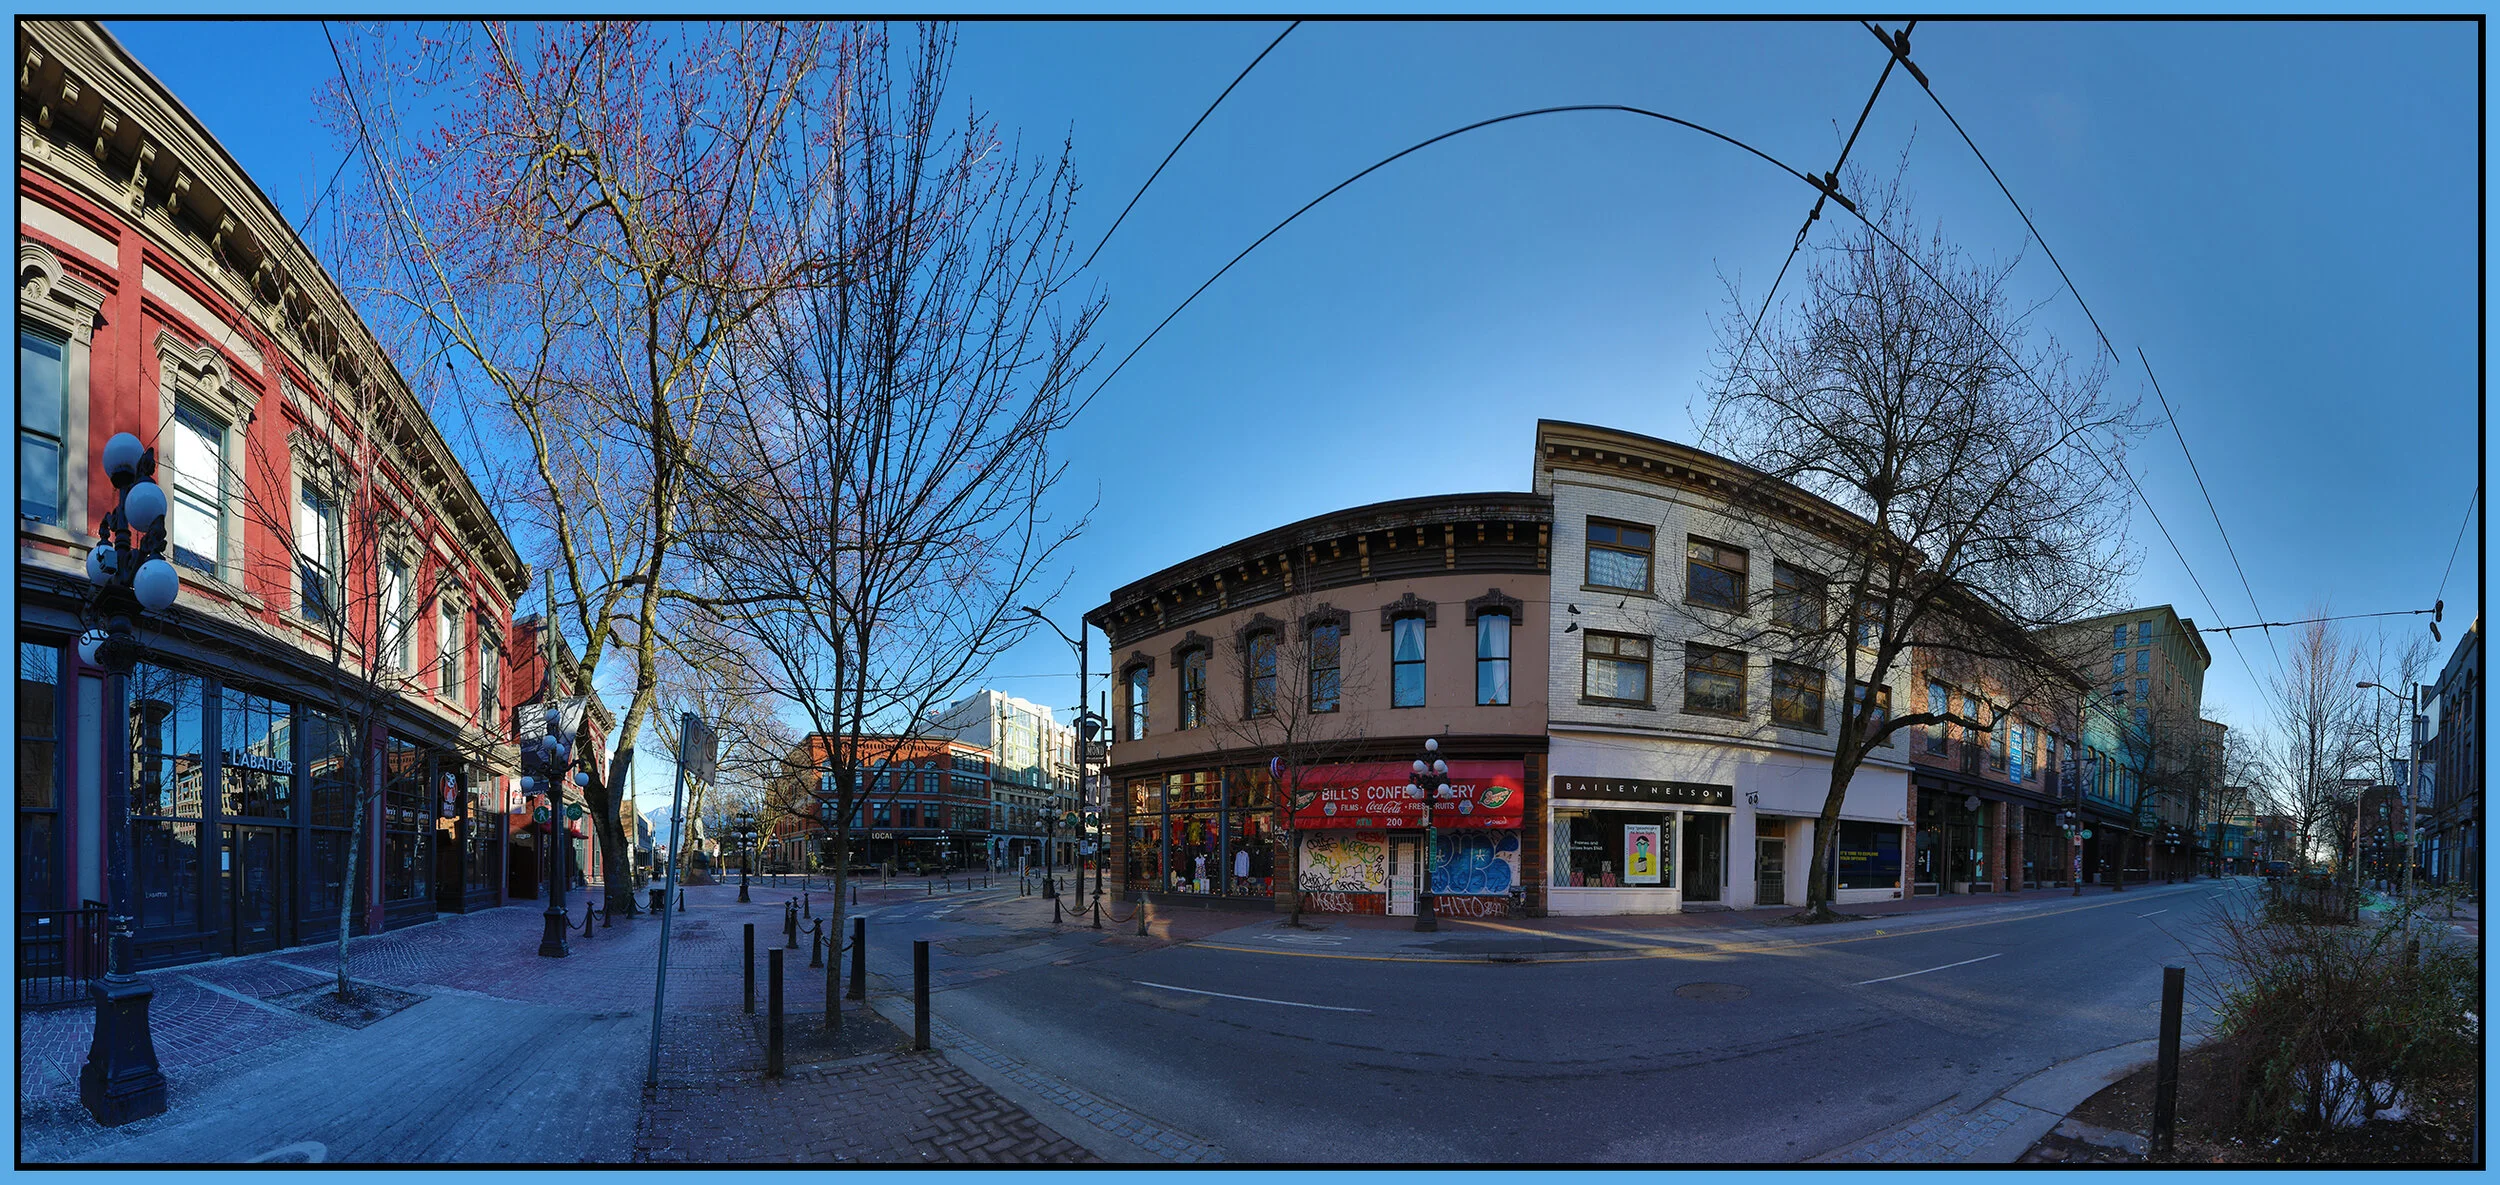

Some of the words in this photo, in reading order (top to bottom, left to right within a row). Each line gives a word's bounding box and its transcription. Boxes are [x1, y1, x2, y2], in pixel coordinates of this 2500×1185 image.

[1321, 787, 1359, 801] BILL'S
[1566, 782, 1638, 793] BAILEY
[1651, 786, 1723, 798] NELSON
[1341, 803, 1359, 812] FILMS
[1408, 802, 1426, 811] FRES
[1434, 802, 1455, 811] RUITS
[1356, 818, 1372, 826] ATM
[1387, 817, 1402, 827] 200
[871, 832, 893, 840] LOCAL
[1433, 896, 1484, 917] HITO
